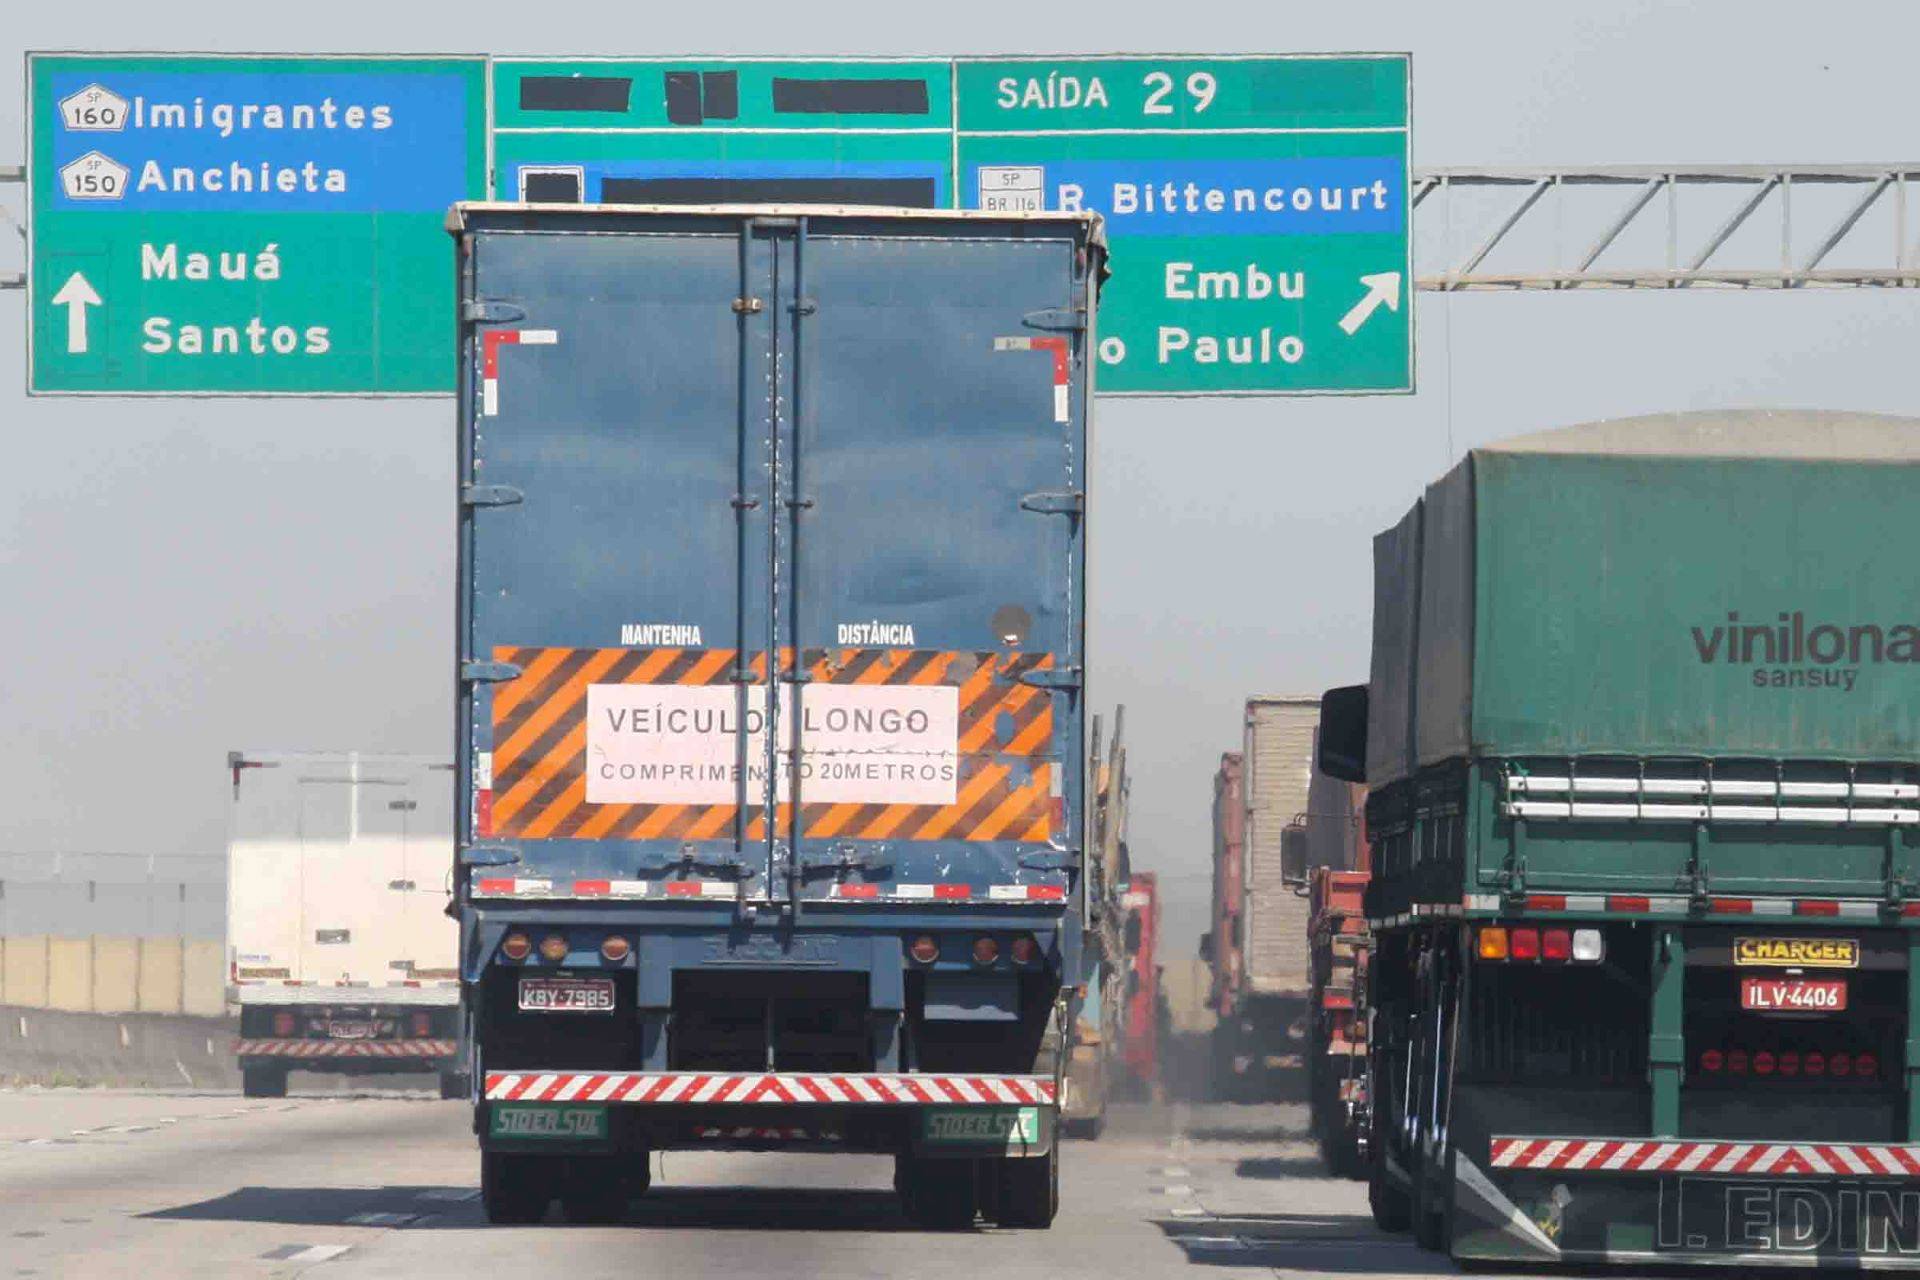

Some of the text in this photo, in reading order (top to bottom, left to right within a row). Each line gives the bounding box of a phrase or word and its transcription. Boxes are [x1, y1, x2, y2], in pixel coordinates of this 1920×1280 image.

[86, 93, 101, 103] SP
[998, 71, 1217, 115] SAÍDA 29
[74, 108, 115, 124] 160
[134, 97, 393, 137] Imigrantes
[86, 160, 101, 170] SP
[137, 160, 347, 193] Anchieta
[1002, 173, 1020, 186] SP
[75, 175, 115, 192] 150
[1113, 180, 1387, 214] Bittencourt
[987, 197, 1007, 211] BR
[141, 243, 282, 281] Mauá
[1165, 262, 1305, 300] Embu
[142, 317, 330, 354] Santos
[1158, 326, 1304, 364] Paulo
[621, 620, 915, 645] MANTENHA DISTÂNCIA
[1691, 611, 1920, 664] vinilona
[1753, 668, 1858, 692] sansuy
[607, 704, 929, 734] VEÍCULO LONGO
[1741, 940, 1852, 965] CHARGER
